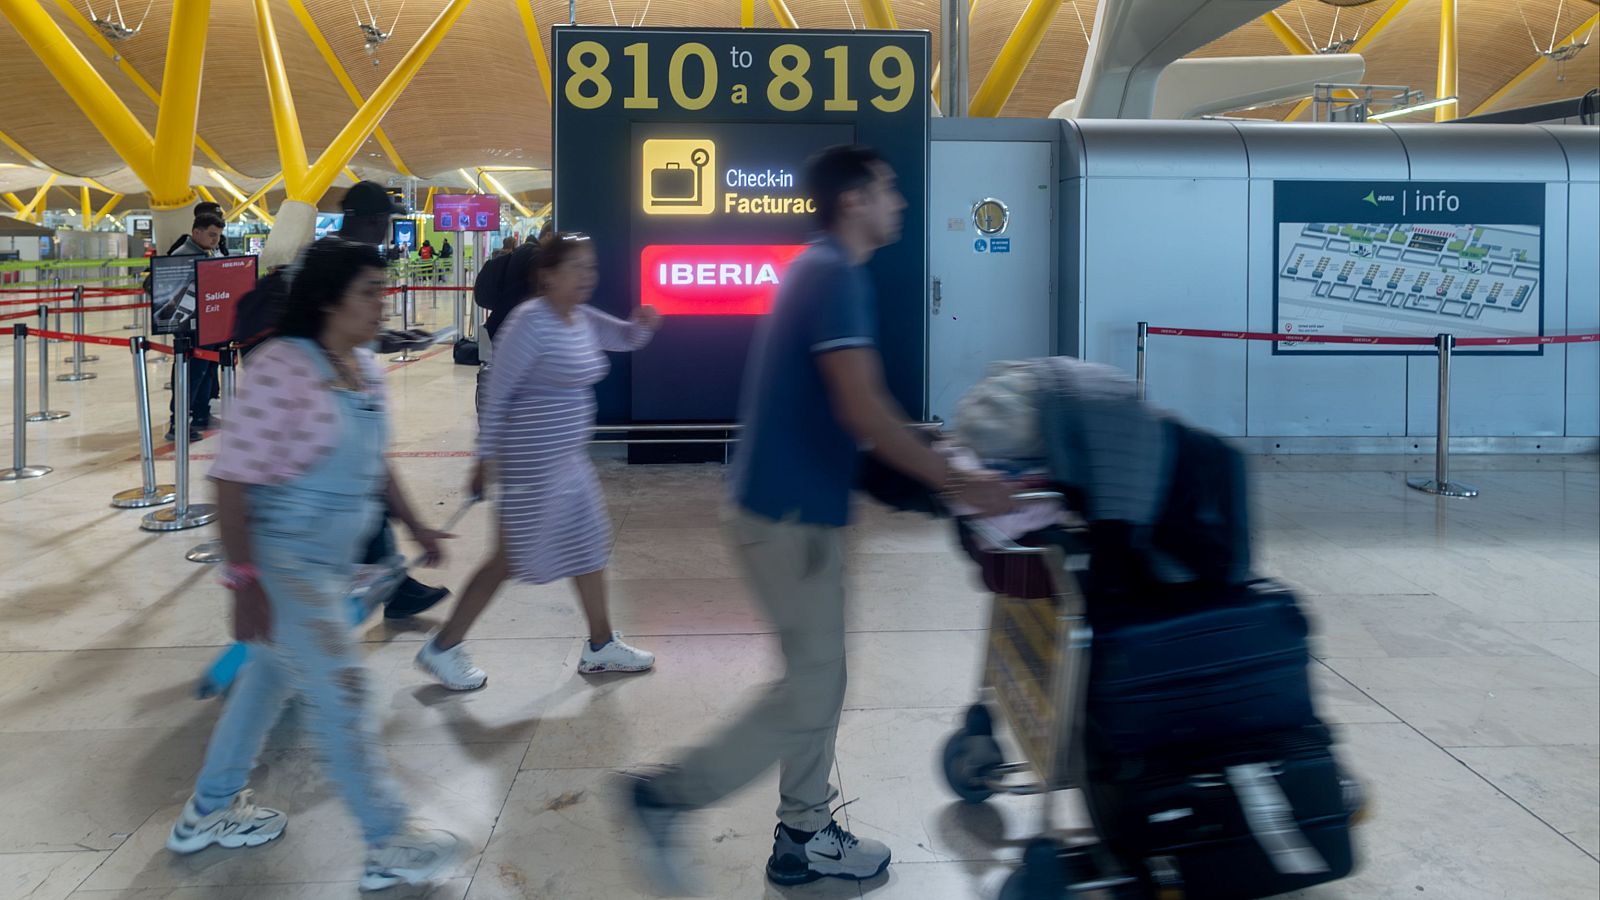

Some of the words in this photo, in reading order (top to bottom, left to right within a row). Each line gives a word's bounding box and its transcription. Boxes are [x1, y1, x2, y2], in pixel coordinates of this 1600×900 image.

[730, 46, 753, 68] to
[565, 41, 718, 110] 810
[767, 44, 915, 112] 819
[731, 83, 748, 104] a
[726, 169, 793, 187] Check-in
[725, 193, 817, 213] Facturac
[1416, 190, 1460, 211] info
[659, 264, 779, 285] IBERIA
[205, 292, 230, 301] Salida
[206, 305, 220, 313] Exit
